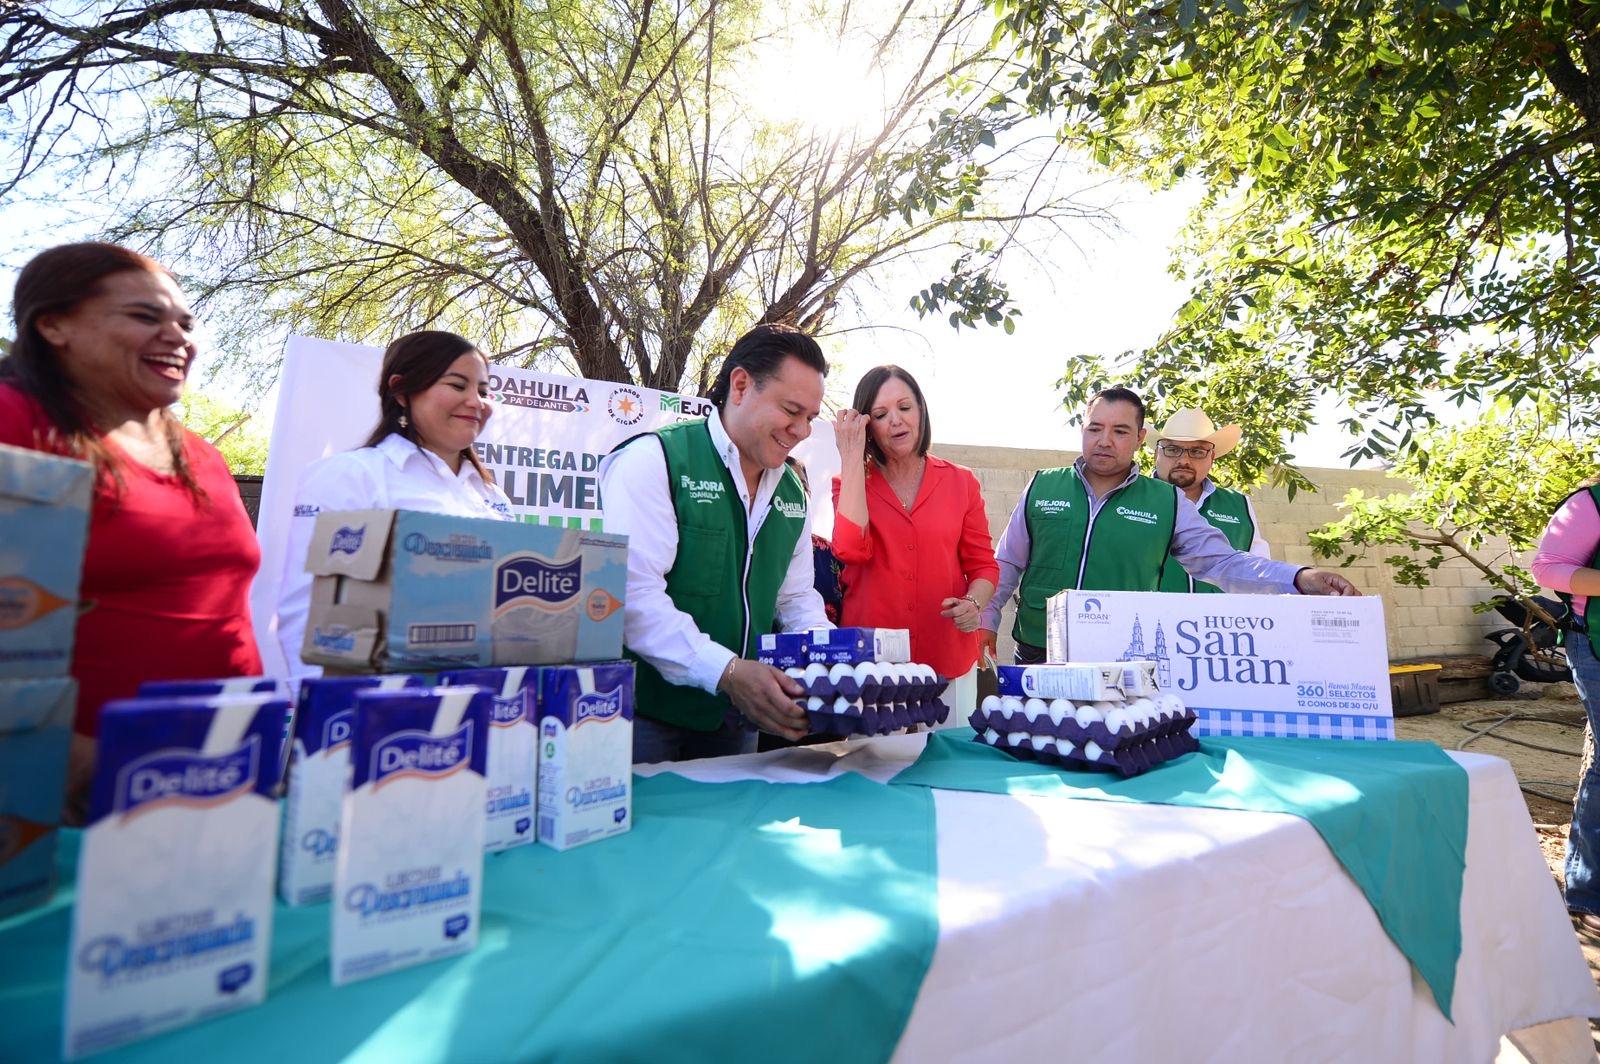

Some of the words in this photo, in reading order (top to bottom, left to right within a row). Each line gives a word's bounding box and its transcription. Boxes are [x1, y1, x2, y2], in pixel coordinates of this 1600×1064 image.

[488, 374, 590, 404] OAHUILA
[526, 398, 569, 412] DELANTE
[660, 393, 713, 418] MEJO
[472, 441, 577, 471] ENTREGA
[582, 453, 607, 472] D
[1035, 500, 1071, 508] MEJORA
[1116, 506, 1158, 520] COAHUILA
[502, 569, 573, 593] Delite
[1078, 612, 1109, 620] PROAN
[1176, 620, 1259, 658] San
[1178, 655, 1291, 692] Juan
[1296, 685, 1325, 697] 360
[1328, 690, 1377, 699] SELECTOS
[494, 702, 519, 720] lite
[578, 697, 616, 718] Delite
[1307, 700, 1338, 708] CONOS
[1362, 702, 1379, 710] C/U
[380, 743, 460, 771] Delite
[129, 763, 239, 801] Delite
